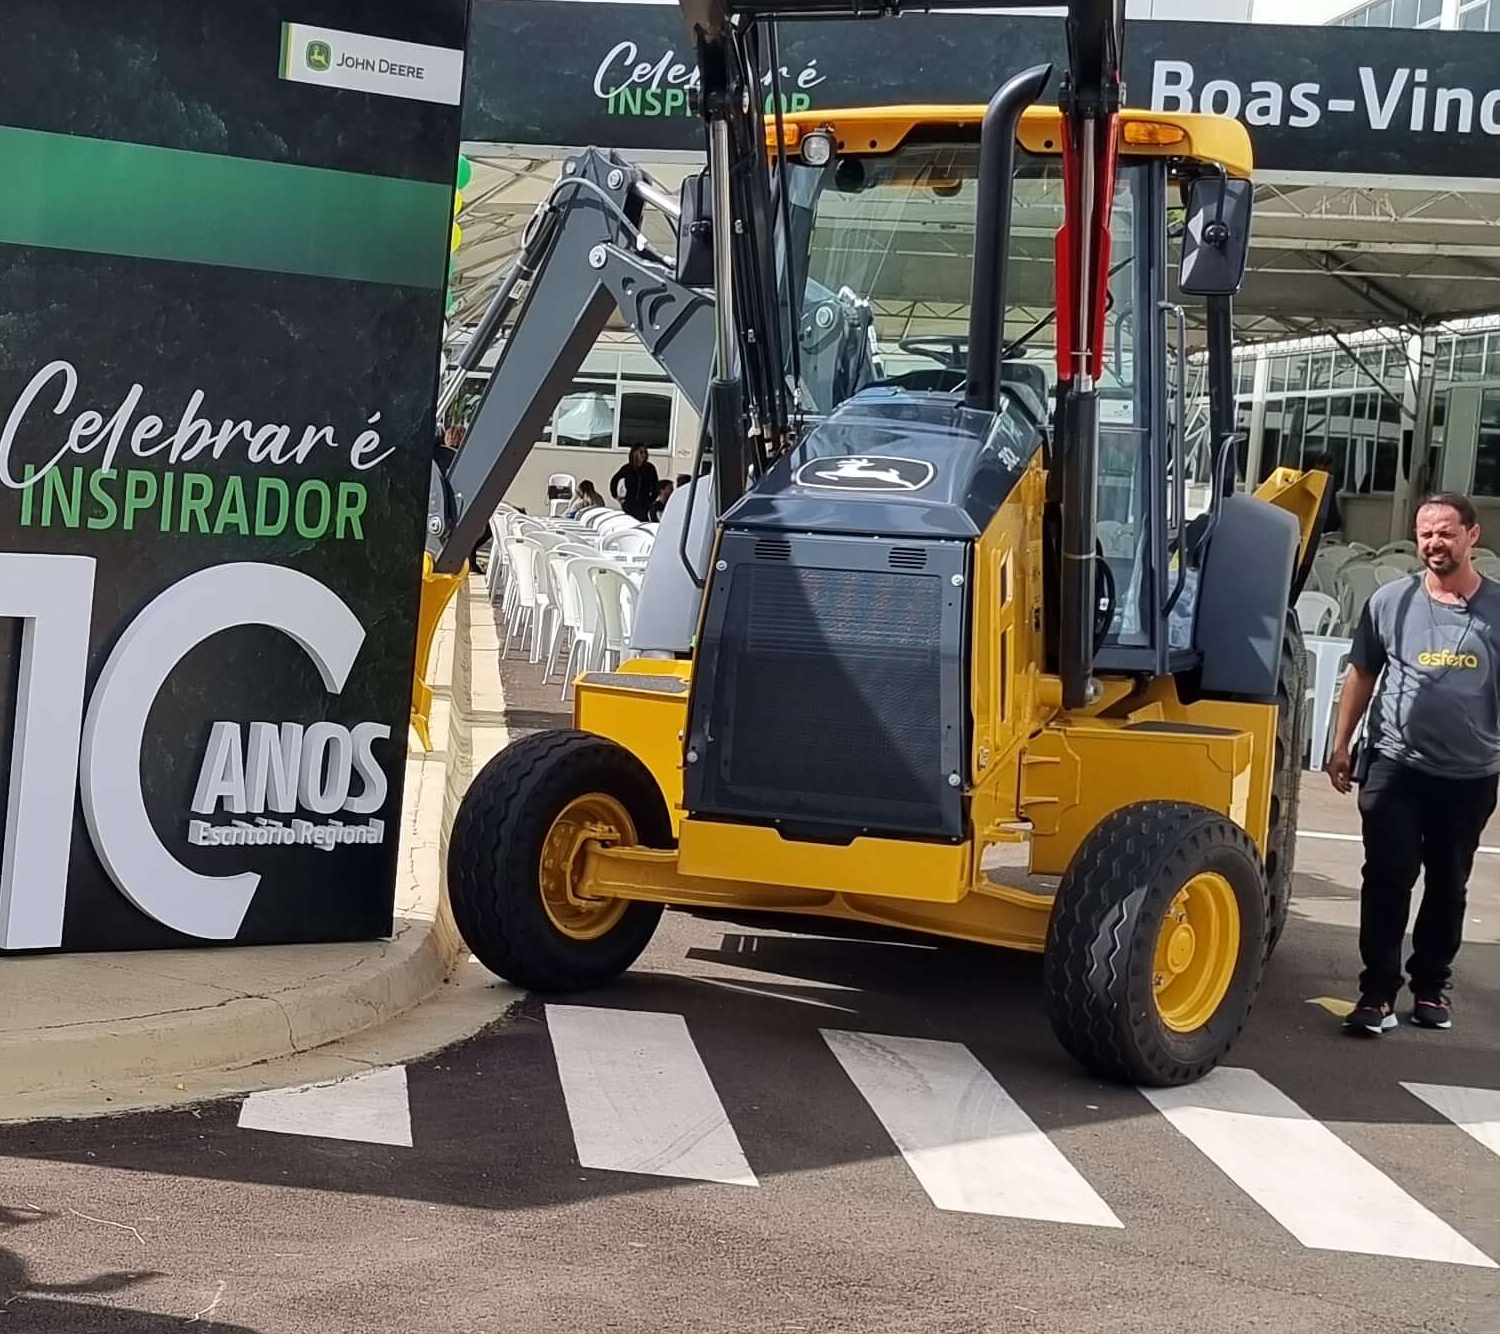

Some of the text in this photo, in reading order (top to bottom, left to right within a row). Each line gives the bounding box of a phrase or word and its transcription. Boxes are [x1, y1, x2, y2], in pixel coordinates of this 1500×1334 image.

[336, 52, 425, 80] JOHN DEERE
[350, 411, 396, 470] é
[20, 463, 368, 541] INSPIRADOR
[1418, 649, 1477, 668] esfera
[190, 721, 391, 814] ANOS
[188, 817, 385, 852] Escritório Regional
